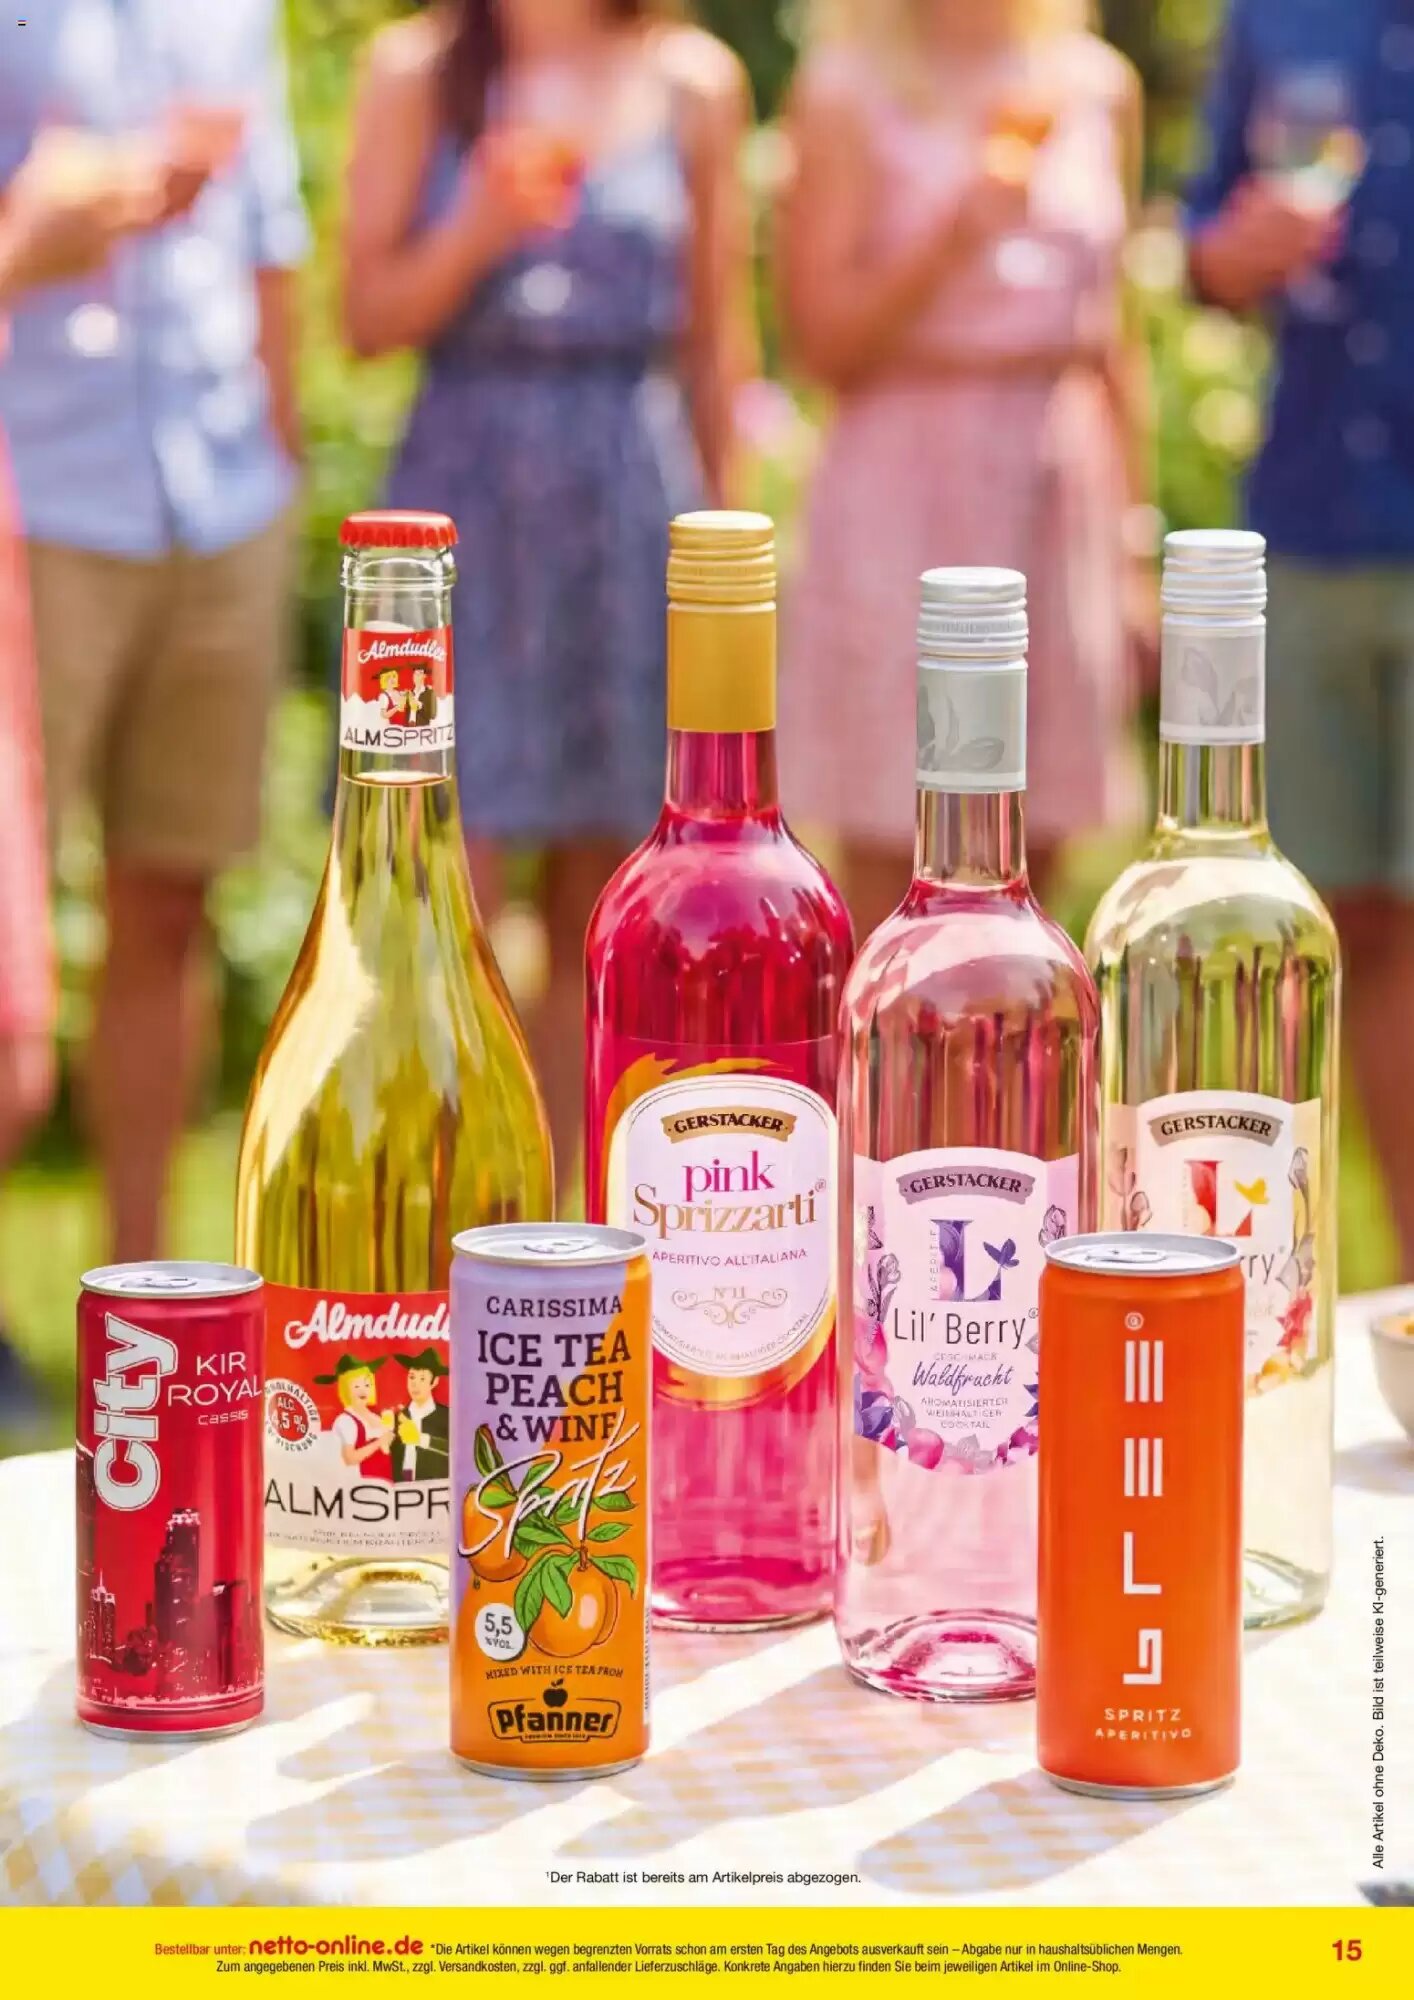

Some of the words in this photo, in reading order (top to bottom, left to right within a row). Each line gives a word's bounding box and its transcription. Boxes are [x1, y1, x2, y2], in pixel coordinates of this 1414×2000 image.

[673, 1113, 784, 1134] GERSTACKER
[1161, 1115, 1273, 1137] GERSTACKER
[682, 1150, 777, 1202] pink
[909, 1173, 1022, 1195] GERSTACKER
[653, 1250, 721, 1267] APERITIVO
[486, 1295, 623, 1318] CARISSIMA
[478, 1330, 542, 1367] ICE
[554, 1330, 633, 1367] TEA
[196, 1352, 247, 1376] KIR
[486, 1371, 624, 1408] PEACH
[912, 1361, 1014, 1396] Waldfrucht
[168, 1375, 262, 1407] ROYAL
[496, 1413, 518, 1441] &
[484, 1612, 513, 1637] 5,5
[486, 1667, 518, 1680] MIXED
[520, 1665, 551, 1675] WITH
[554, 1665, 573, 1675] ICE
[575, 1665, 596, 1675] TEA
[597, 1665, 624, 1678] FROM
[1104, 1707, 1181, 1722] SPRITZ
[1095, 1727, 1192, 1741] APERITIVO
